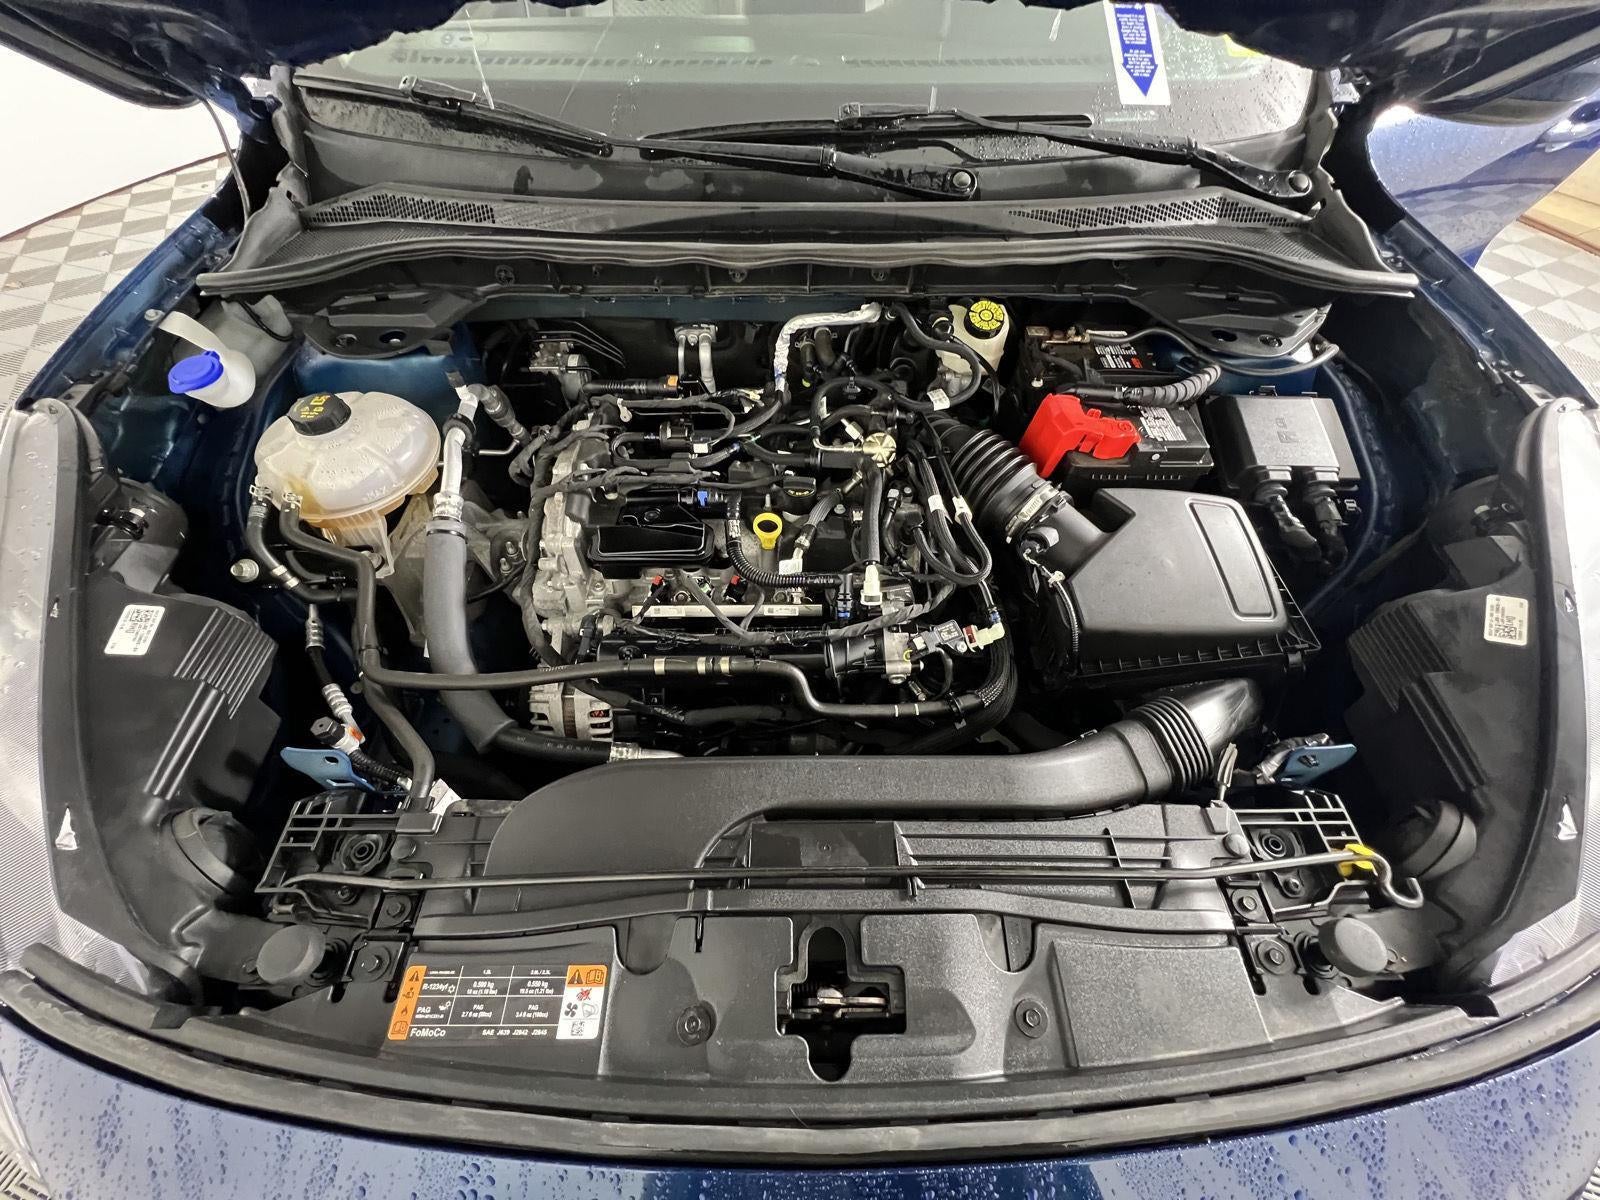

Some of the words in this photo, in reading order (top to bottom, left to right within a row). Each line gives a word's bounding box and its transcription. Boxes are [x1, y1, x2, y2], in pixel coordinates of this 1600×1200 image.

[422, 983, 448, 992] R-1234yf
[487, 981, 494, 989] kg
[541, 981, 548, 989] kg
[410, 1028, 446, 1037] FoMoCo
